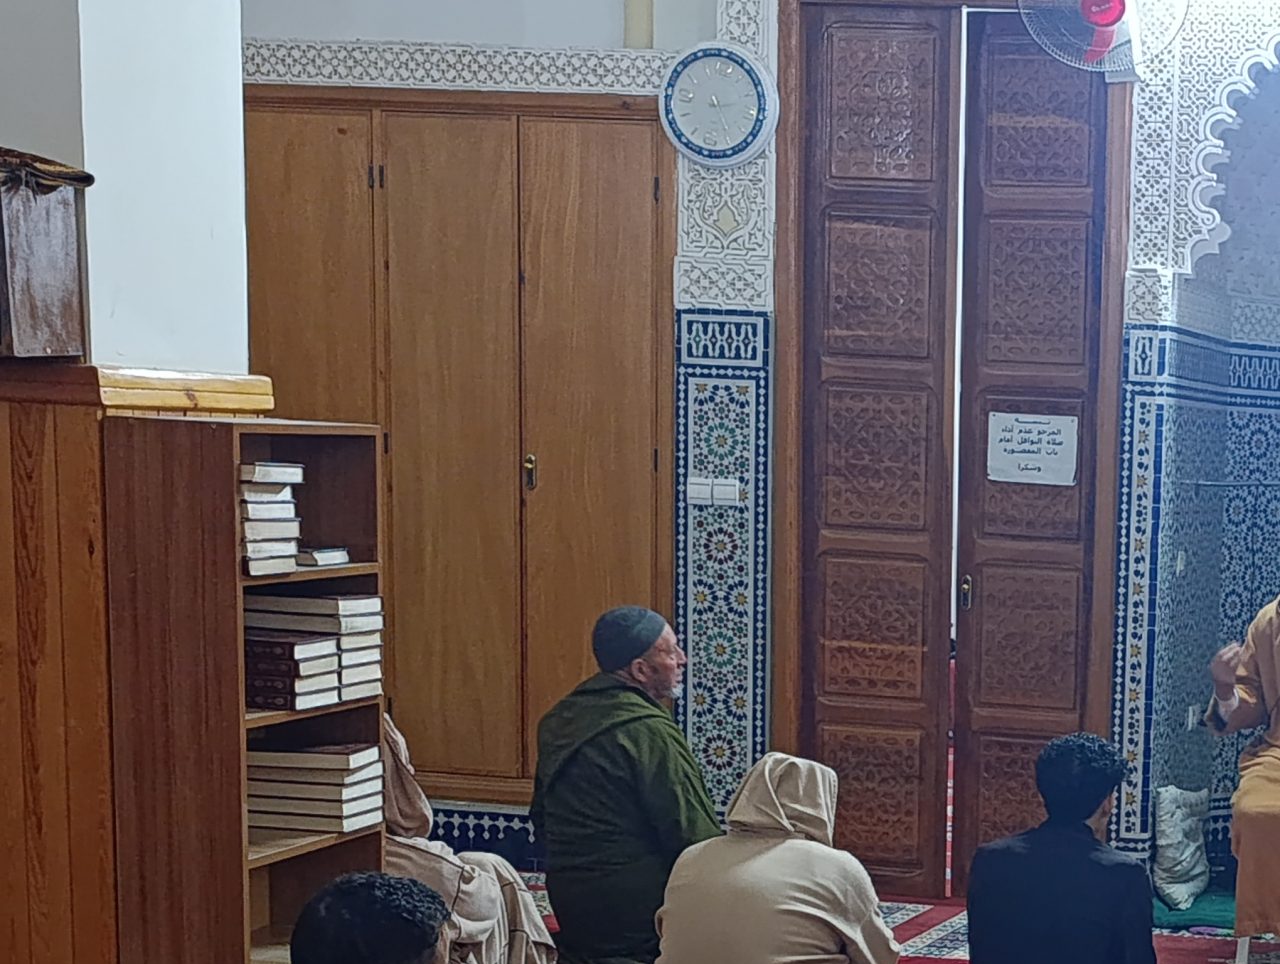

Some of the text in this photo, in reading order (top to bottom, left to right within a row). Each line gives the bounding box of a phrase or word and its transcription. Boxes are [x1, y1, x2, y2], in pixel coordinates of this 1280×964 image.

[1017, 427, 1033, 435] عدم
[998, 435, 1013, 443] أمام
[1017, 436, 1043, 446] النوافل
